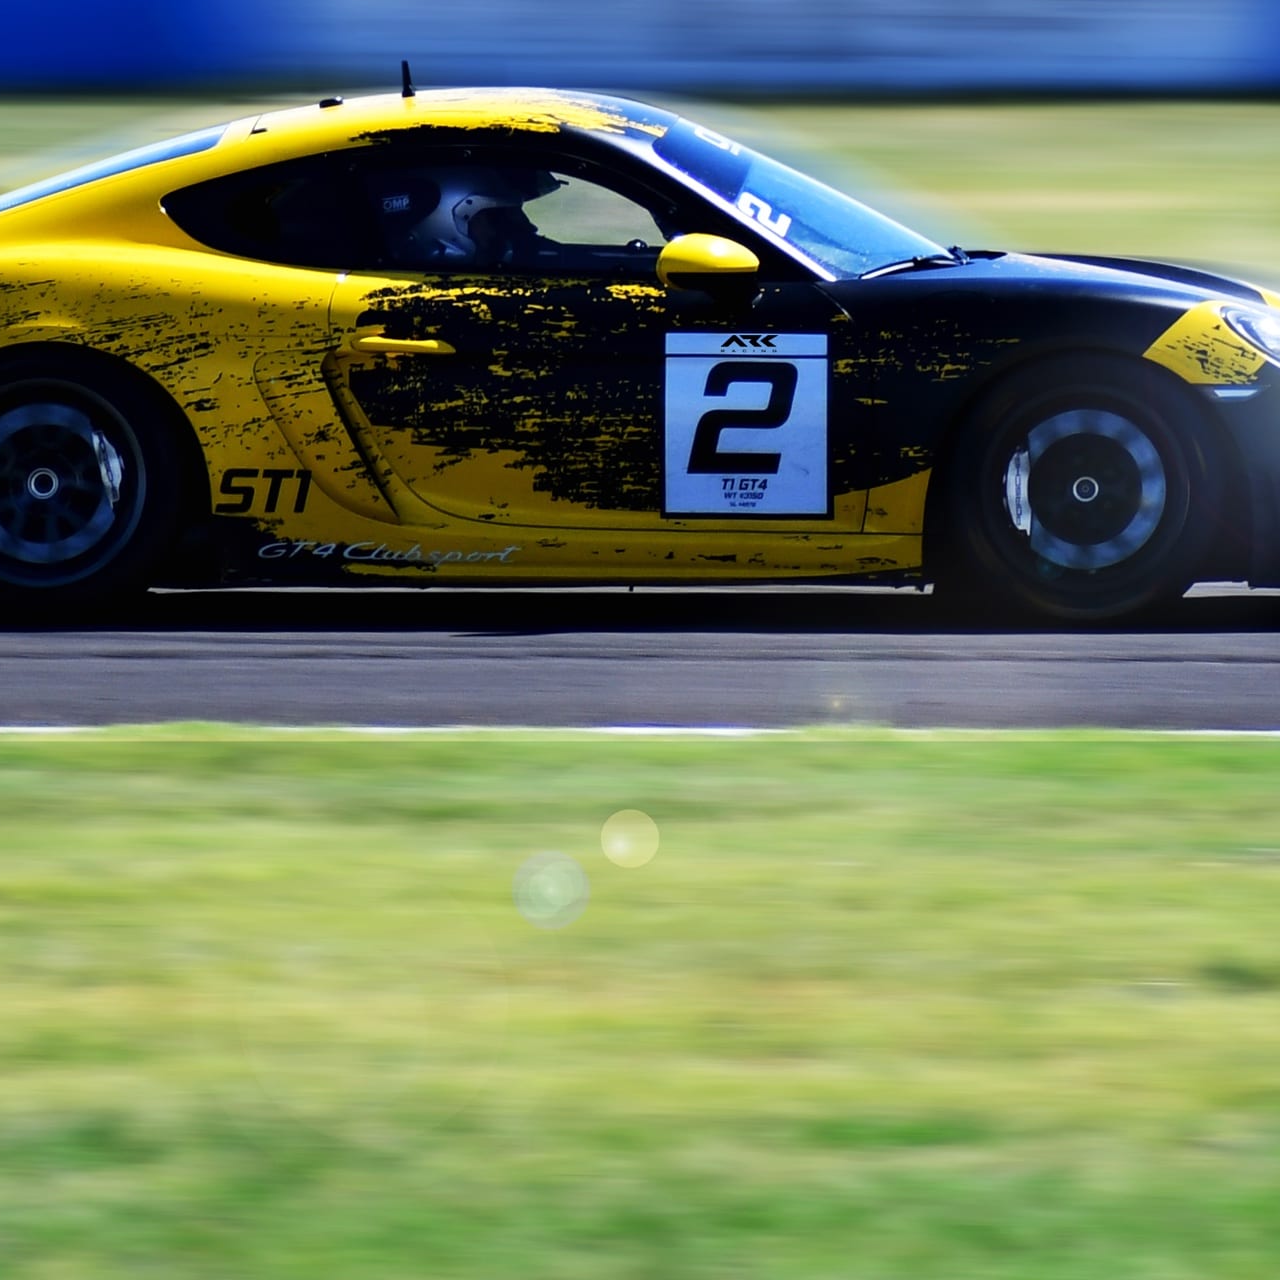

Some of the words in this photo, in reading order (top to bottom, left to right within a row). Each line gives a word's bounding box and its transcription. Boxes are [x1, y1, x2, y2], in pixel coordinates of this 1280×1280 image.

[721, 335, 779, 347] ARK
[686, 361, 799, 475] 2
[214, 468, 312, 514] ST1
[738, 478, 768, 491] GT4
[342, 541, 521, 565] Clubsport
